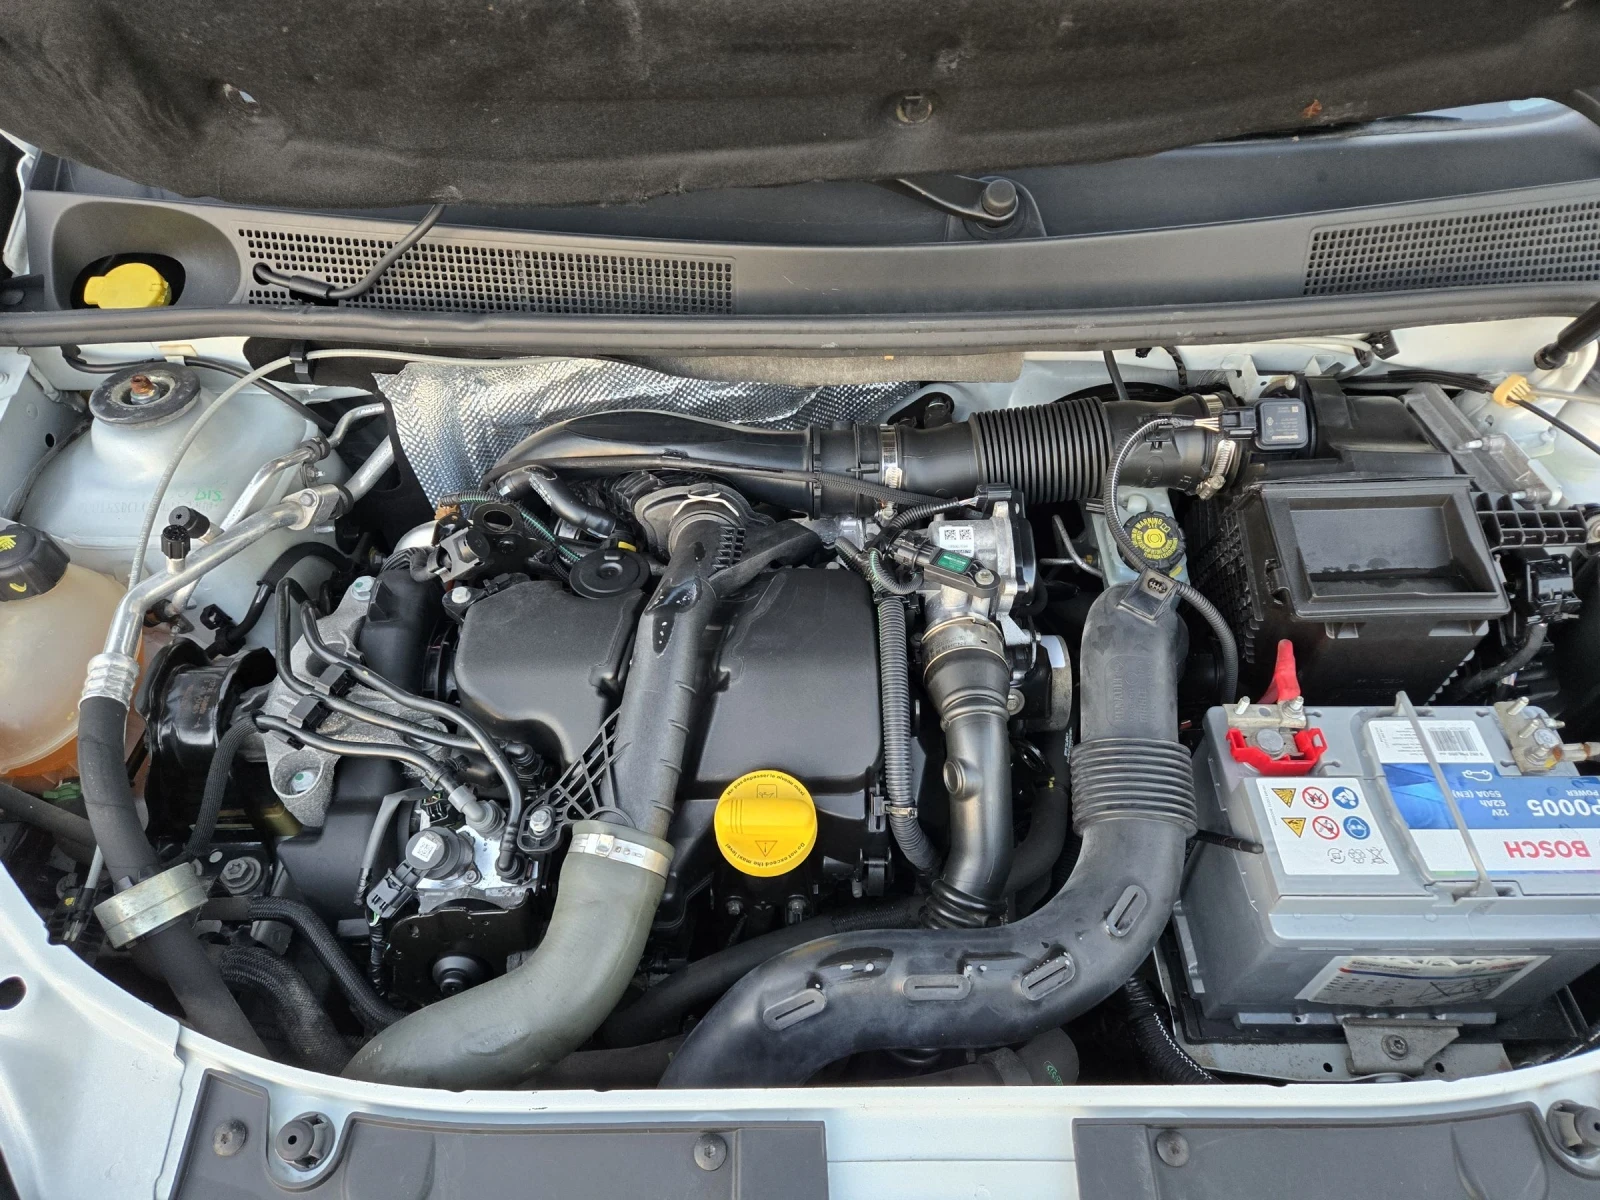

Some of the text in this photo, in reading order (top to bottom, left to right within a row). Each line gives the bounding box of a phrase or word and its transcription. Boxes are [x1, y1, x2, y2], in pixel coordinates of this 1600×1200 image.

[1134, 517, 1163, 529] WARNING
[733, 780, 744, 789] pas
[793, 784, 805, 796] maxi
[1451, 789, 1502, 798] 550A (EN)
[1565, 789, 1599, 797] POWER
[1479, 799, 1506, 807] 62Ah
[1491, 808, 1510, 816] 12V
[725, 843, 738, 857] level
[797, 842, 805, 851] Do
[1503, 840, 1592, 859] BOSCH
[736, 854, 752, 864] maxi
[788, 850, 798, 859] not
[765, 857, 788, 867] exceed
